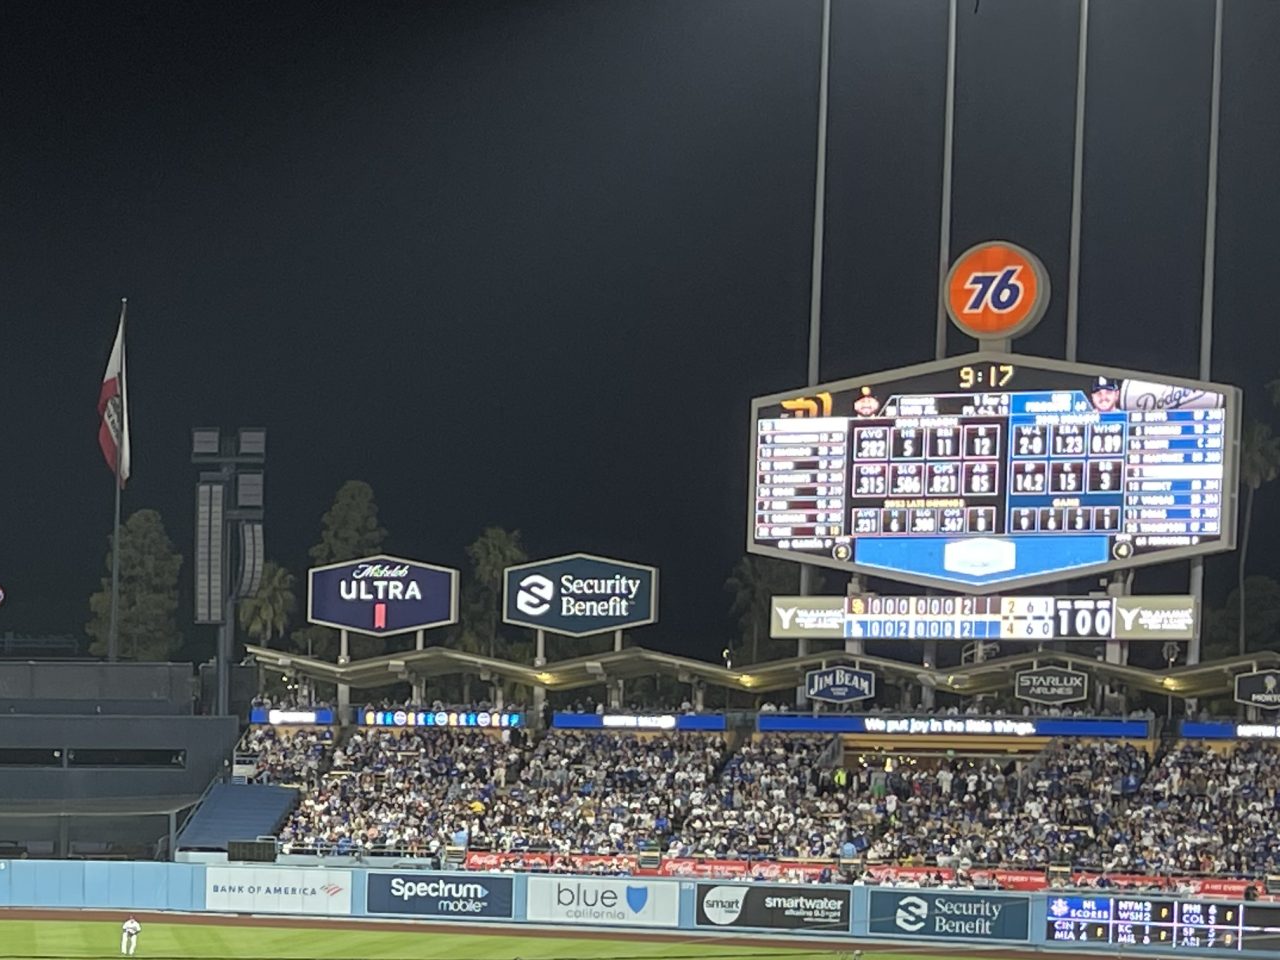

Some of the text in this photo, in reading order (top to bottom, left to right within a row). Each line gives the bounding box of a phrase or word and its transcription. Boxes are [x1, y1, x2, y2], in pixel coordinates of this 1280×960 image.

[964, 266, 1024, 314] 76
[959, 365, 1013, 388] 9:17
[861, 430, 882, 439] AVG
[1060, 426, 1078, 434] ERA
[1094, 425, 1121, 433] WHIP
[904, 441, 912, 456] 5
[939, 440, 951, 455] 11
[974, 439, 989, 454] 12
[1056, 436, 1082, 453] 1.23
[857, 476, 884, 493] .315
[930, 476, 955, 491] .821
[1017, 475, 1043, 490] 14.2
[1060, 475, 1075, 489] 15
[1101, 473, 1110, 489] 3
[837, 547, 846, 557] 2
[1119, 546, 1127, 556] 4
[340, 581, 421, 600] ULTRA
[560, 574, 640, 599] Security
[560, 597, 629, 617] Benefit
[1008, 601, 1014, 613] 2
[1006, 623, 1013, 634] 4
[810, 669, 869, 696] JIM BEAM
[1020, 676, 1082, 687] STARLUX
[1029, 687, 1073, 695] AIRLINES
[865, 718, 886, 731] We
[887, 719, 909, 732] put
[910, 718, 929, 733] joy
[930, 718, 942, 731] in
[944, 719, 965, 732] the
[994, 720, 1036, 735] things.
[212, 885, 317, 896] BANK OF AMERICA
[391, 878, 483, 901] Spectrum
[557, 882, 617, 908] blue
[438, 897, 482, 912] mobile
[705, 897, 741, 911] smart
[764, 895, 844, 910] smartwater
[935, 897, 1002, 919] Security
[1083, 900, 1096, 909] NL
[565, 906, 626, 920] california
[1070, 909, 1108, 919] SCORES
[1118, 911, 1151, 921] WSH 2
[1182, 915, 1215, 925] COL 3
[935, 917, 992, 934] Benefit
[1054, 921, 1087, 932] CIN 7
[1118, 924, 1132, 933] KC
[1054, 930, 1087, 941] MIA 4
